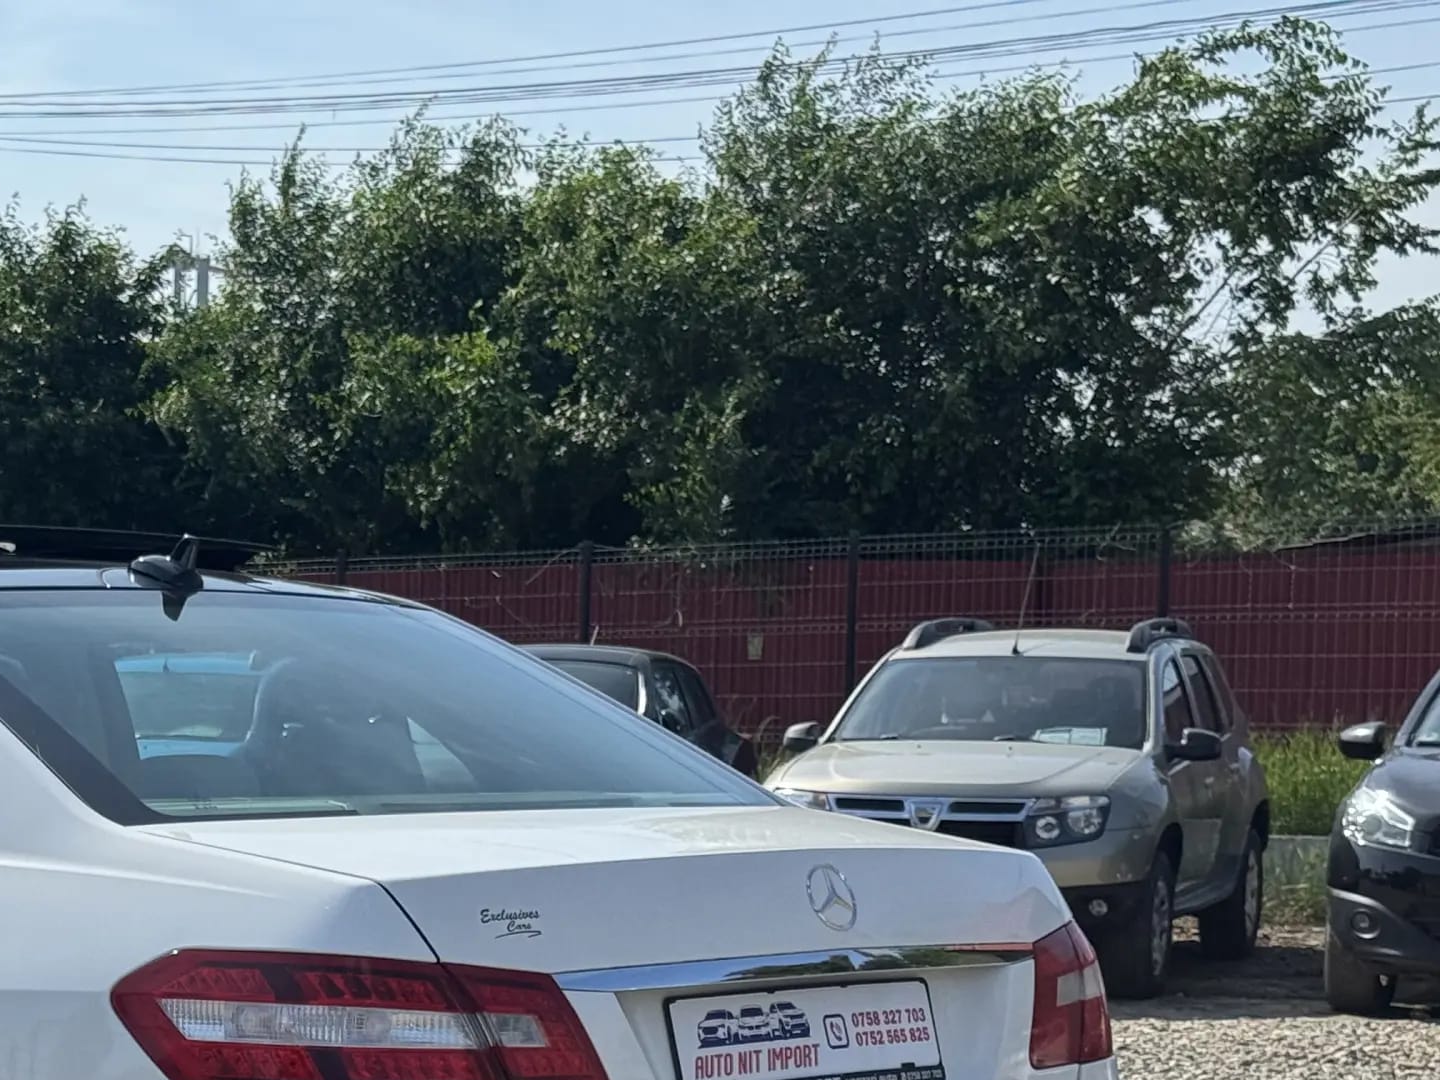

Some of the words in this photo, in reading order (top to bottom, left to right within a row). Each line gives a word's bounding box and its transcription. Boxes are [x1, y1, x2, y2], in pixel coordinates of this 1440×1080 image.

[480, 908, 540, 924] Exclusives
[506, 920, 533, 933] Cars
[851, 1010, 881, 1028] 0758
[882, 1008, 903, 1026] 327
[904, 1007, 927, 1024] 703
[855, 1030, 886, 1047] 0752
[886, 1028, 908, 1045] 565
[909, 1026, 931, 1043] 825
[694, 1053, 734, 1080] AUTO
[738, 1049, 762, 1075] NIT
[767, 1043, 820, 1072] IMPORT
